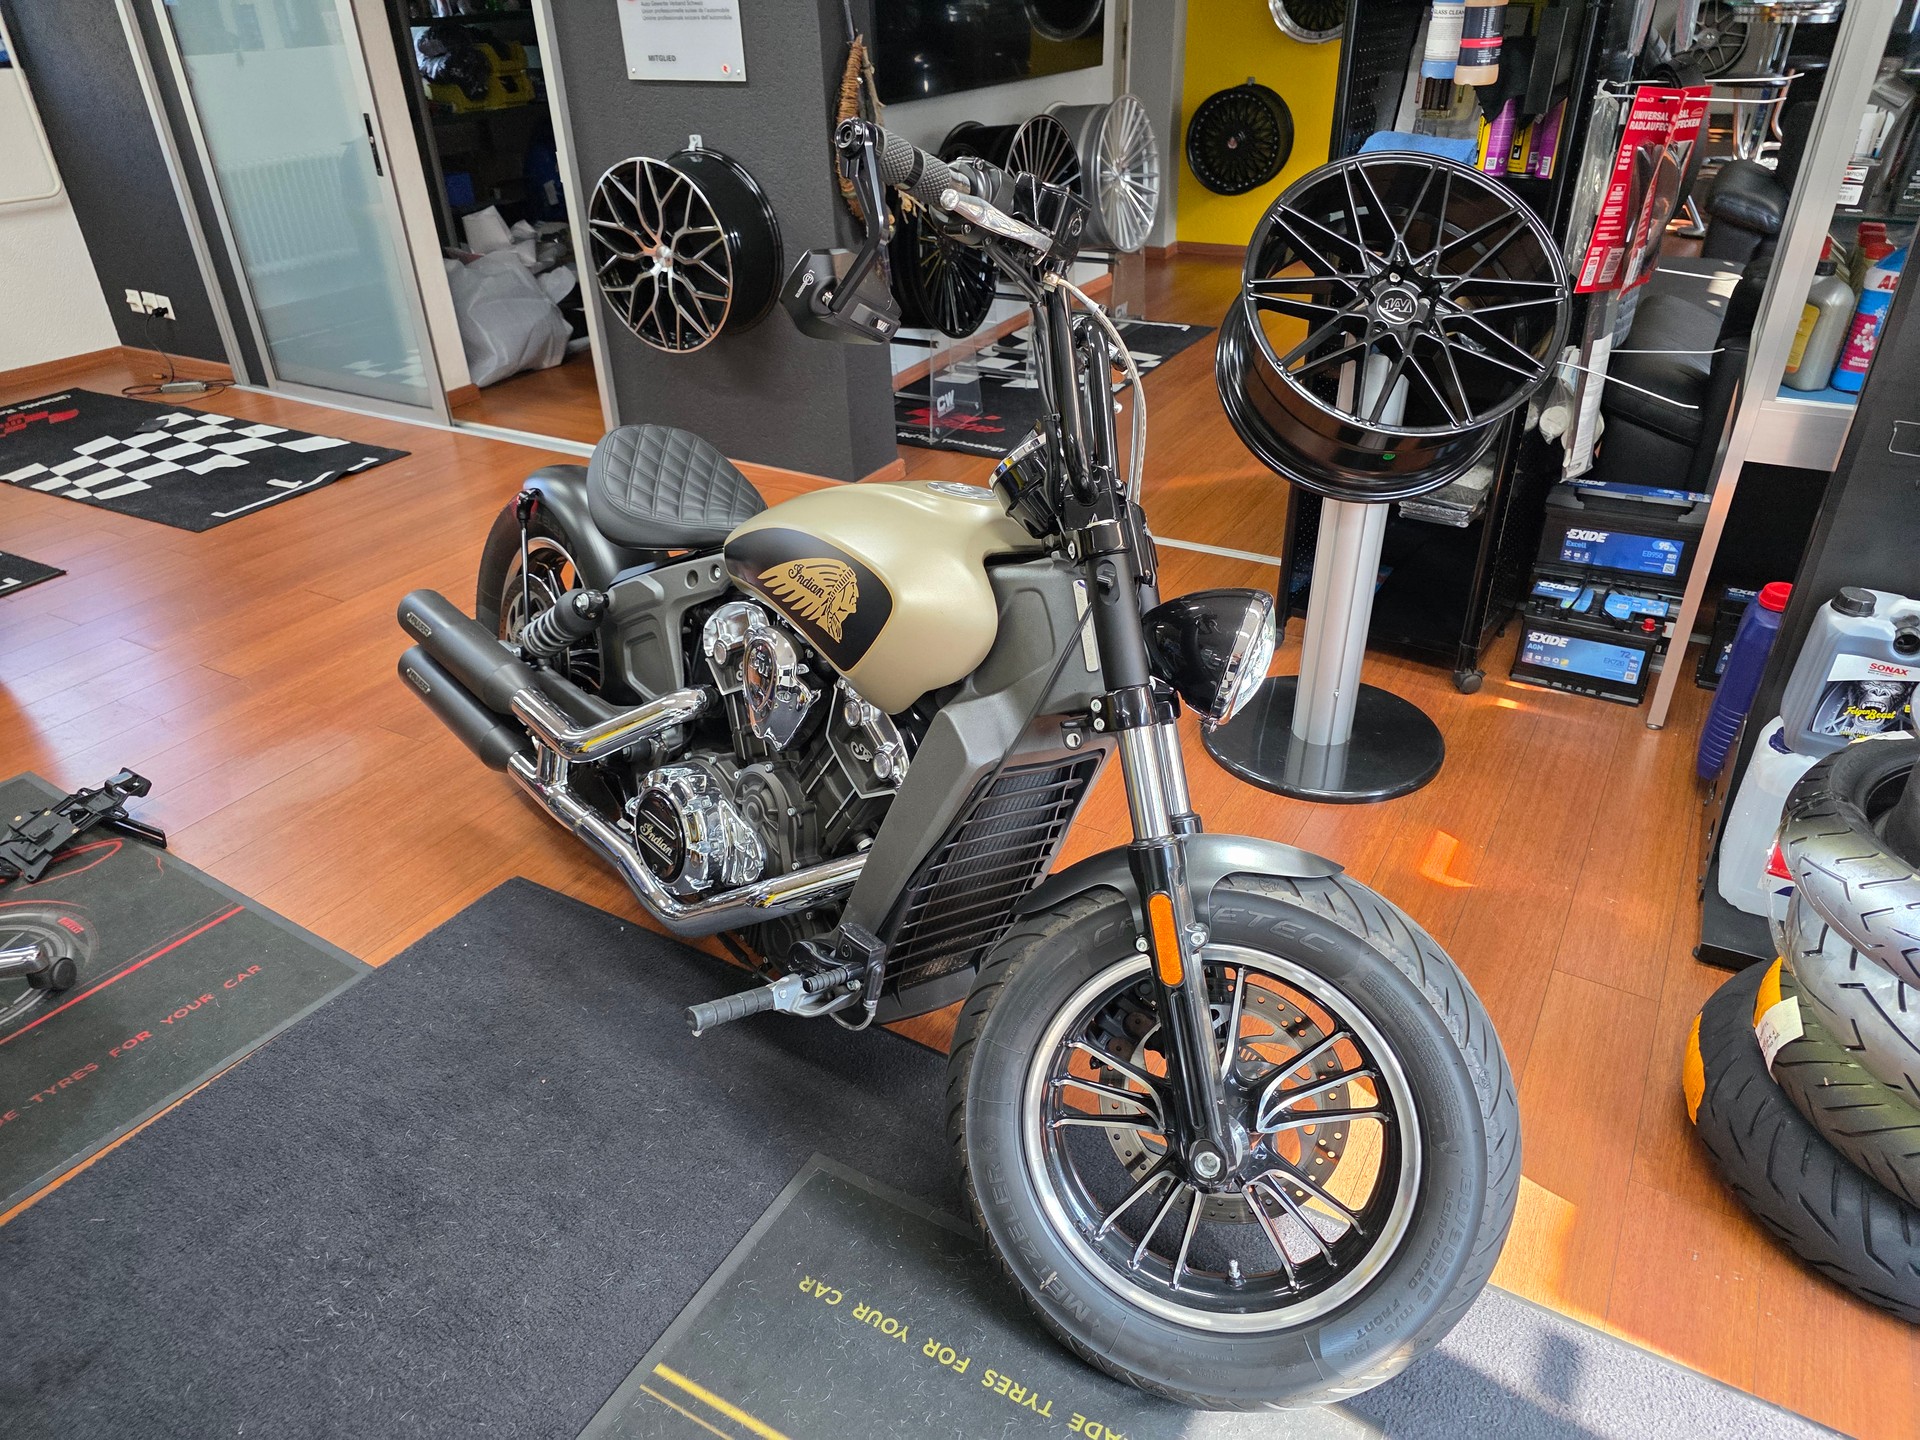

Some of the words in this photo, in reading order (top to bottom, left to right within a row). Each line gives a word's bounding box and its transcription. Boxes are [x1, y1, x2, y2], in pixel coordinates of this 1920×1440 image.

[1632, 110, 1669, 121] UNIVERSAL
[1566, 529, 1609, 543] EXIDE
[1566, 540, 1587, 549] Excell
[787, 564, 825, 598] Indian
[1538, 581, 1580, 593] EXIDE
[1527, 642, 1544, 651] AGM
[1528, 632, 1570, 648] EXIDE
[1620, 650, 1632, 659] 72
[1869, 663, 1909, 676] SONAX
[640, 822, 673, 857] Indian
[28, 1062, 100, 1103] TYRES
[109, 1030, 153, 1058] FOR
[160, 993, 215, 1025] YOUR
[223, 964, 262, 989] CAR
[985, 1161, 1092, 1322] METZELER
[798, 1275, 843, 1305] CAR
[852, 1302, 910, 1344] YOUR
[922, 1337, 971, 1374] FOR
[981, 1368, 1053, 1418] TYRES
